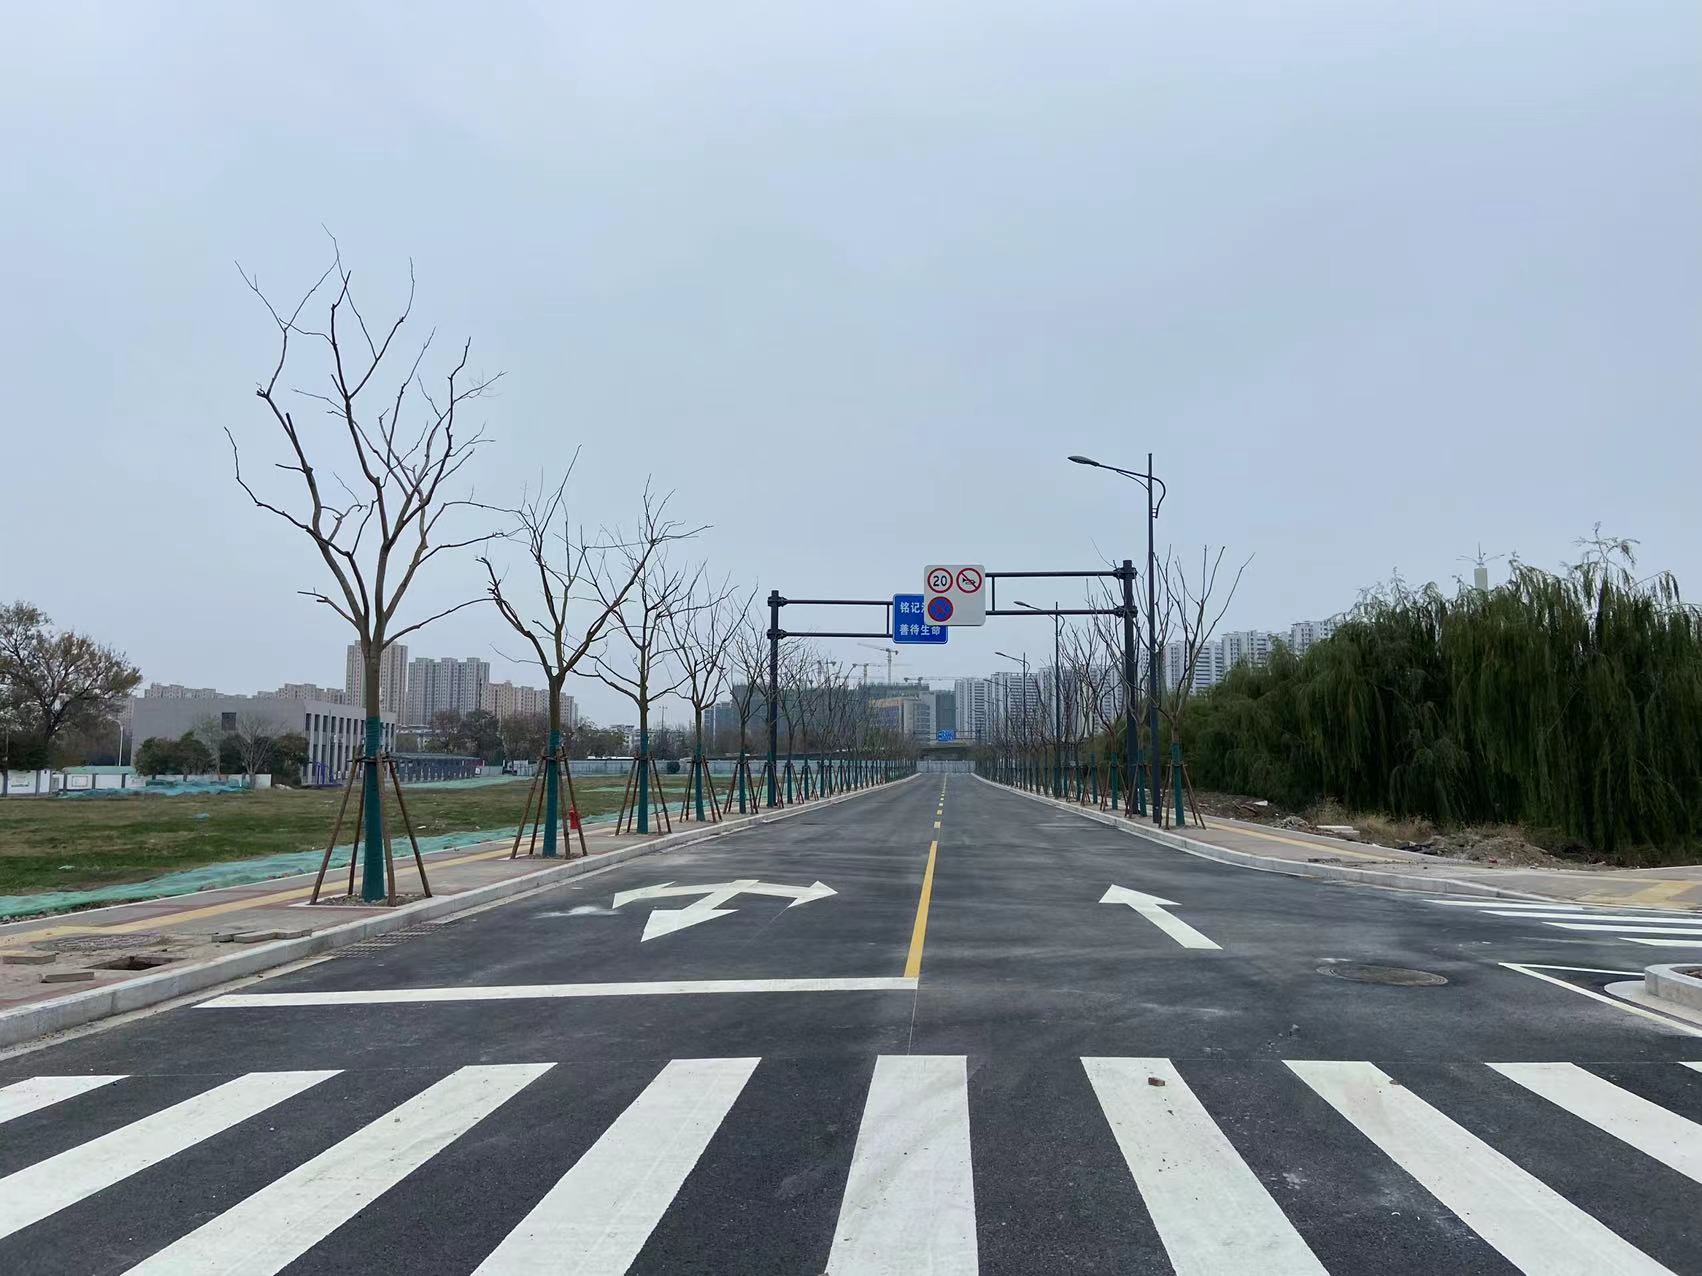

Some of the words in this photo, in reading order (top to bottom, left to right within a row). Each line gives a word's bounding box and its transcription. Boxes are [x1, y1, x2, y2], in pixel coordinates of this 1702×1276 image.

[933, 575, 948, 587] 20
[900, 624, 941, 636] 善待生命
